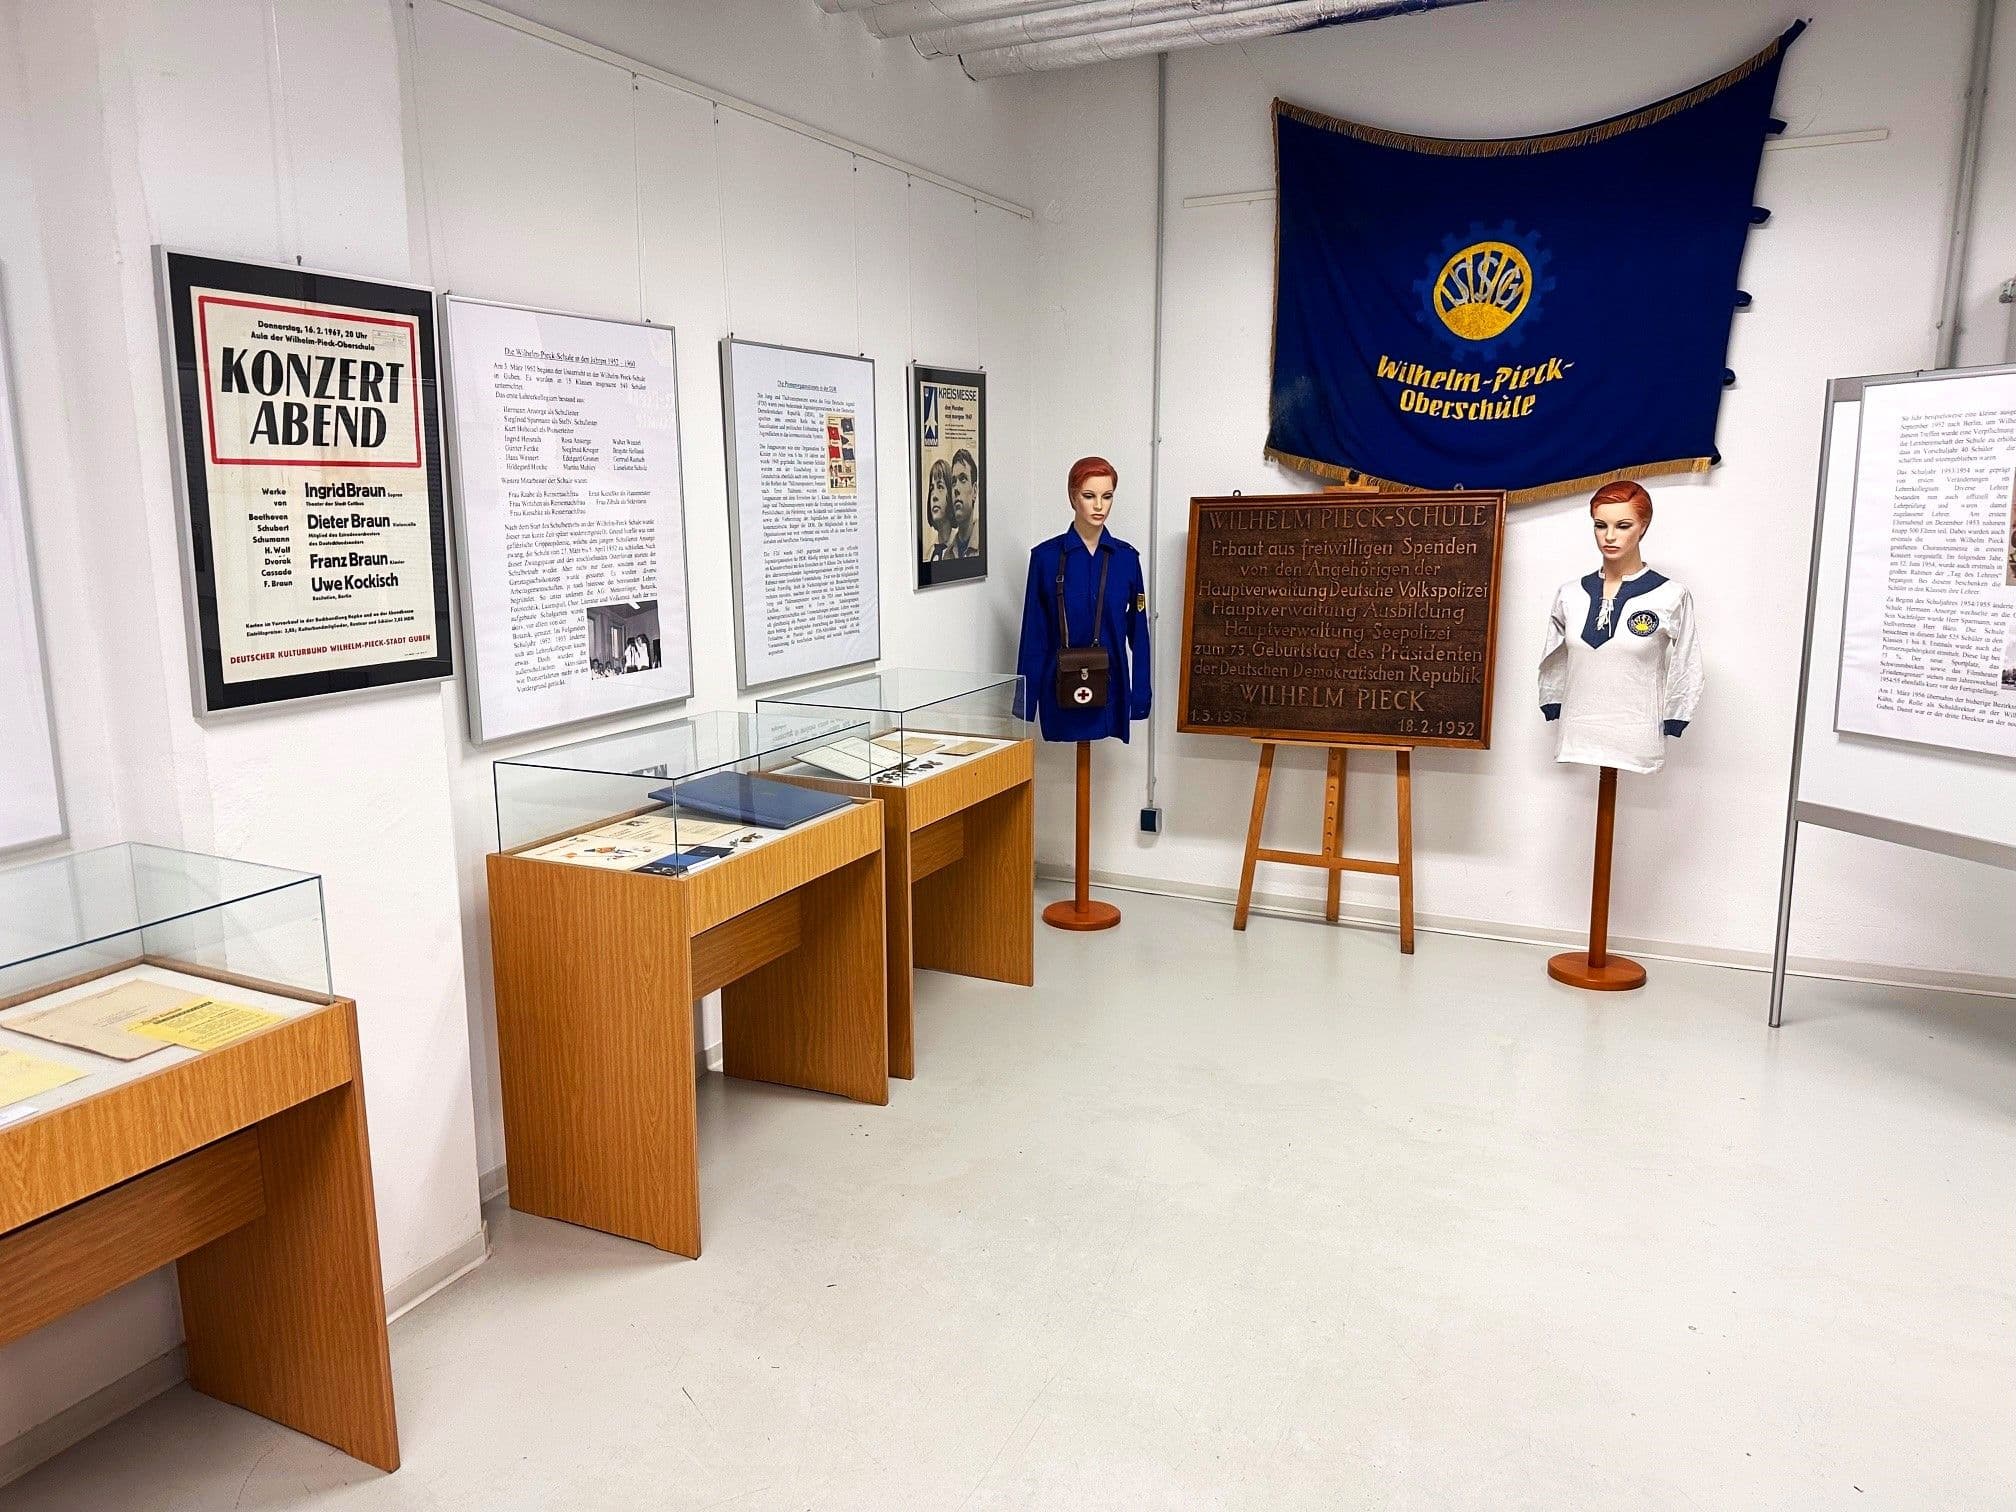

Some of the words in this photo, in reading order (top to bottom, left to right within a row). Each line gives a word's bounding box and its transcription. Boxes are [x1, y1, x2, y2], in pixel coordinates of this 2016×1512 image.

[251, 331, 268, 341] Aula
[270, 333, 283, 342] der
[286, 335, 375, 351] Wilhelm-Pieck-Oberschule
[258, 321, 303, 334] Donnerstag,
[356, 331, 367, 339] Uhr
[221, 347, 404, 404] KONZERT
[1377, 355, 1575, 393] Wilhelm-Pieck-
[939, 387, 976, 401] KREISMESSE
[250, 401, 387, 448] ABEND
[262, 488, 286, 496] Werke
[305, 482, 345, 499] Ingrid
[347, 483, 386, 497] Braun
[249, 513, 288, 521] Beethoven
[307, 514, 349, 529] Dieter
[351, 514, 390, 528] Braun
[1209, 510, 1311, 529] WILHELM
[1320, 506, 1487, 529] PIECK-SCHULE
[1212, 540, 1264, 556] Erbaut
[1268, 545, 1294, 555] aus
[1301, 538, 1392, 560] freiwilligen
[1402, 537, 1477, 559] Spenden
[310, 554, 347, 569] Franz
[350, 552, 388, 567] Braun
[1240, 566, 1268, 576] von
[1275, 560, 1301, 576] den
[1307, 559, 1410, 580] Angehörigen
[1415, 559, 1441, 576] der
[312, 577, 342, 591] Uwe
[344, 573, 399, 589] Kockisch
[1329, 578, 1393, 597] Deutsche
[1399, 581, 1488, 602] Volkspolizei
[1212, 601, 1356, 621] Hauptverwaltung
[1363, 601, 1464, 624] Ausbildung
[1225, 620, 1364, 643] Hauptverwaltung
[1373, 623, 1450, 645] Seepolizei
[230, 652, 275, 664] DEUTSCHER
[278, 646, 328, 658] KULTURBUND
[330, 637, 406, 652] WILHELM-PIECK-STADT
[408, 634, 431, 643] GUBEN
[1194, 645, 1224, 656] zum
[1252, 641, 1339, 659] Geburtstag
[1347, 643, 1374, 659] des
[1381, 643, 1482, 662] Präsidenten
[1193, 659, 1217, 674] der
[1220, 660, 1288, 677] Deutschen
[1294, 662, 1403, 681] Demokratischen
[1409, 665, 1480, 688] Republik
[1240, 684, 1344, 708] WILHELM
[1357, 689, 1425, 711] PIECK
